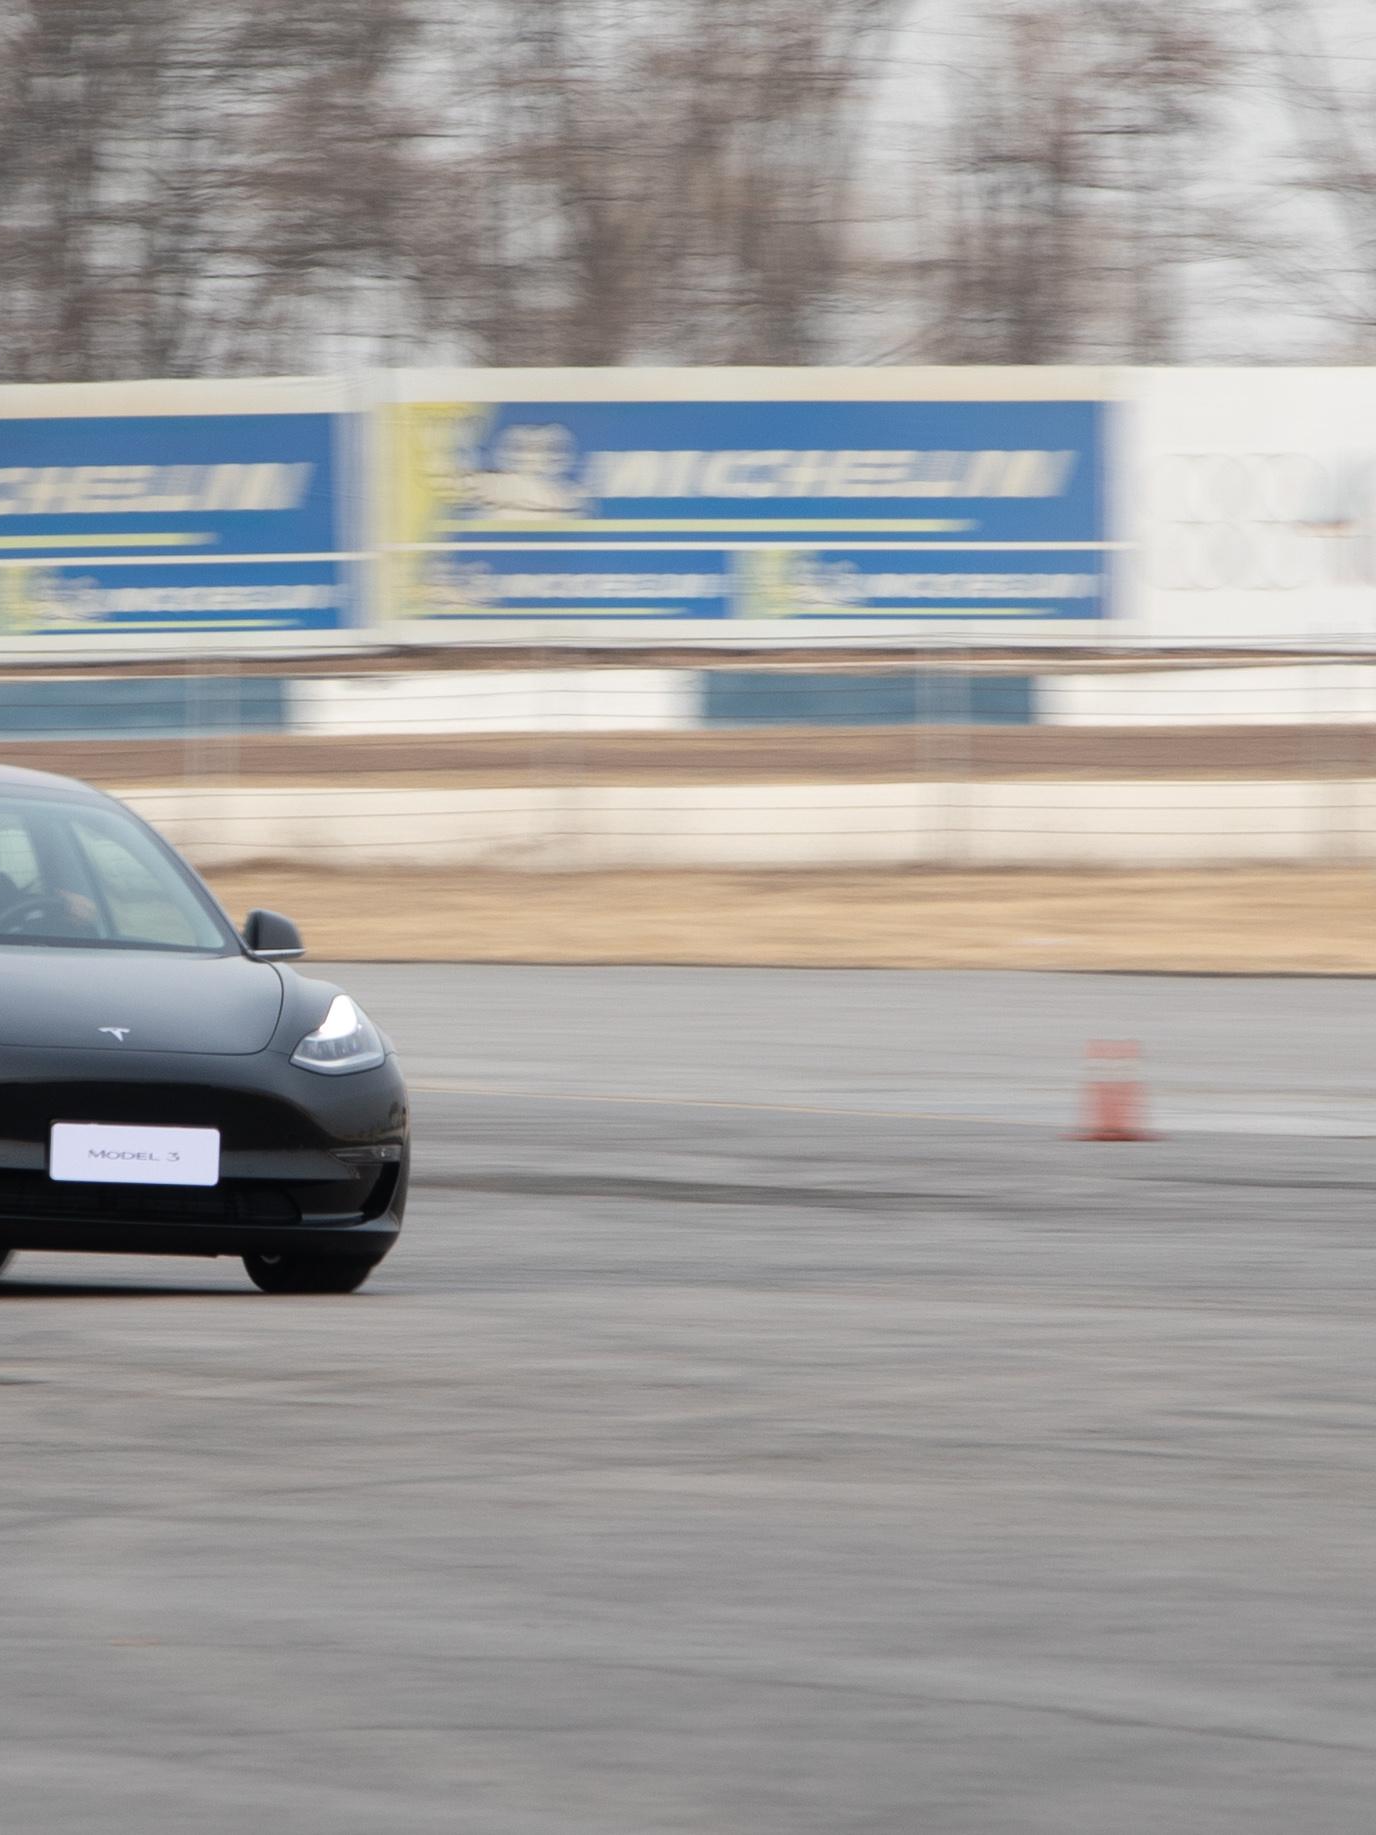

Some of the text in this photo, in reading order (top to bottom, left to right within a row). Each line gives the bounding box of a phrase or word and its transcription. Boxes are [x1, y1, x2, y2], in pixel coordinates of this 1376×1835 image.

[580, 449, 1078, 499] MICHELIN
[87, 1149, 180, 1162] MODEL 3
